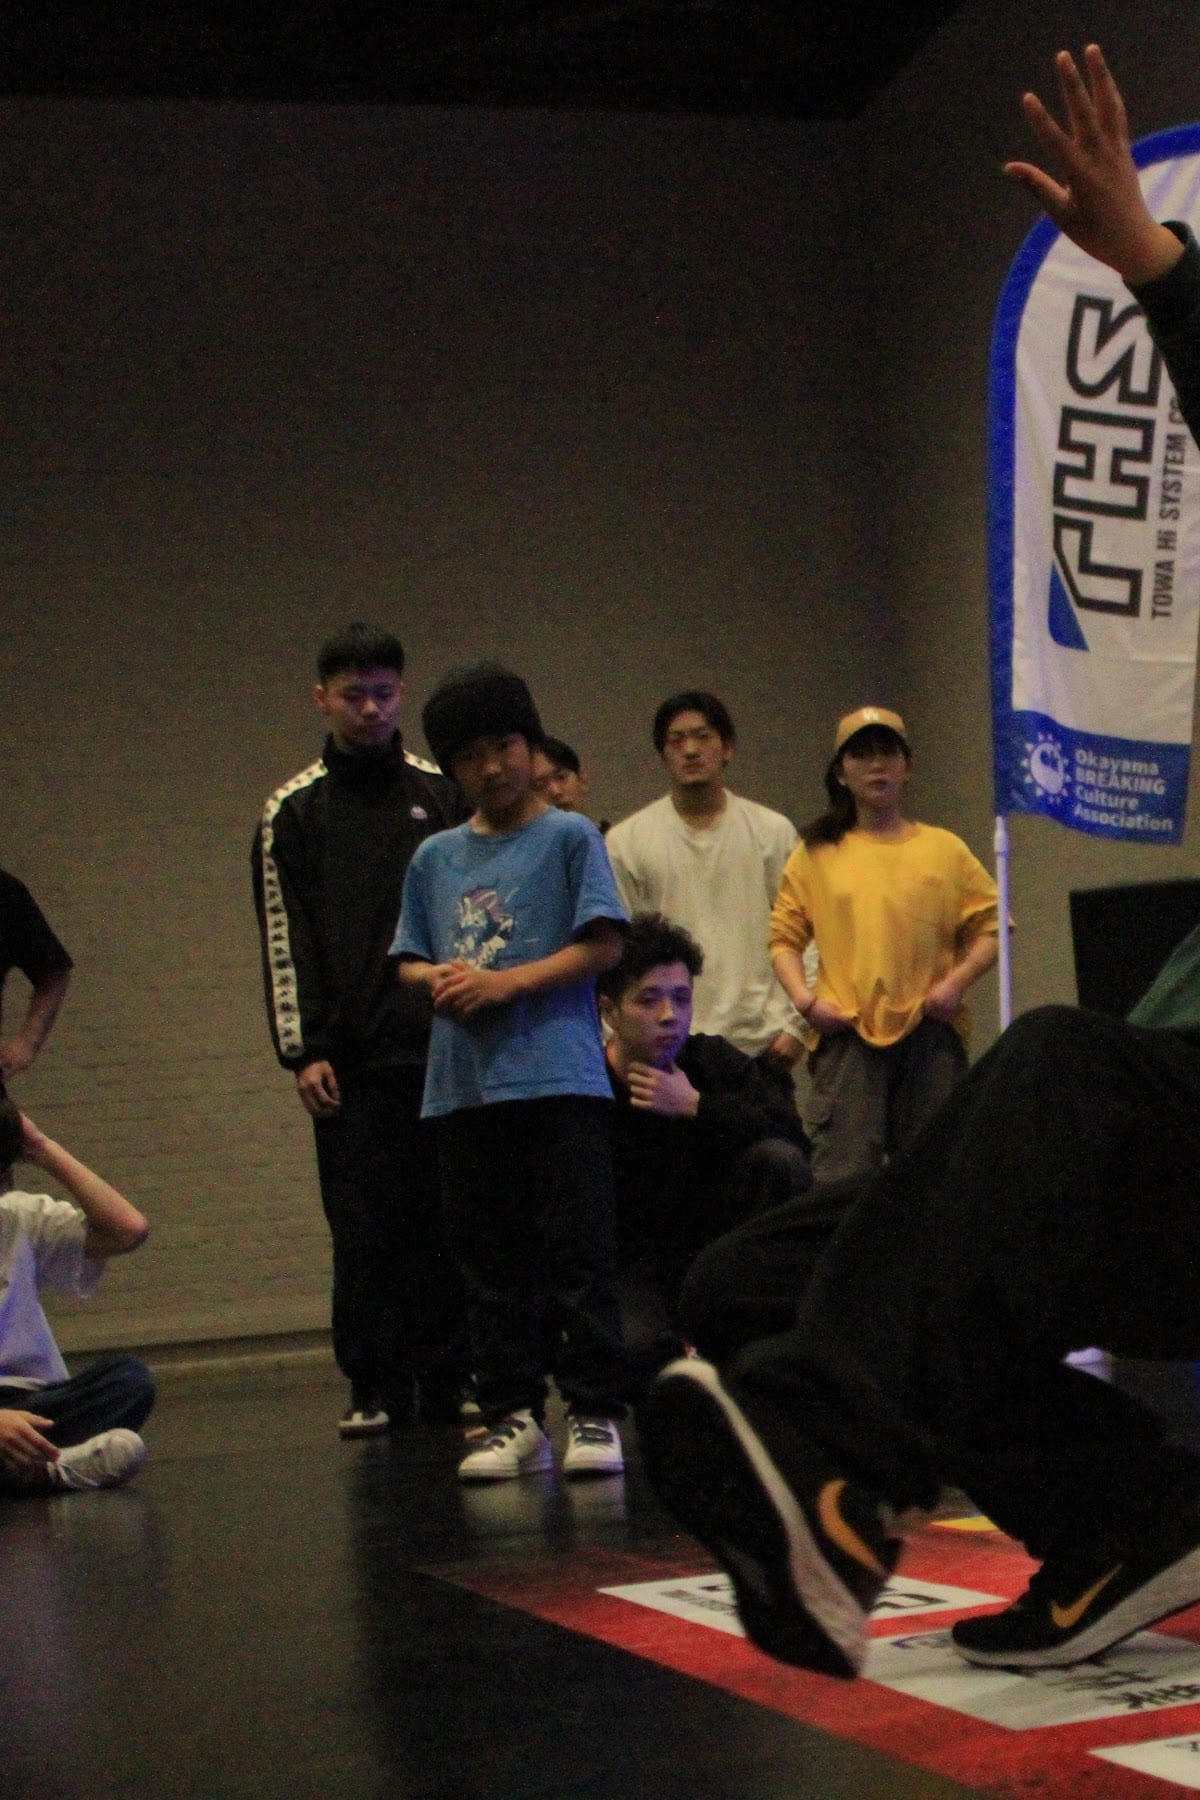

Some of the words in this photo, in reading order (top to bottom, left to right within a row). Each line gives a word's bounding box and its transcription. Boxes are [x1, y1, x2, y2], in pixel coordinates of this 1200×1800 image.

[1159, 433, 1187, 521] SYSTEM
[1151, 560, 1175, 620] TOWA
[1074, 748, 1160, 776] Okayama
[1074, 767, 1167, 796] BREAKING
[1074, 785, 1140, 811] Culture
[1073, 803, 1174, 831] Association
